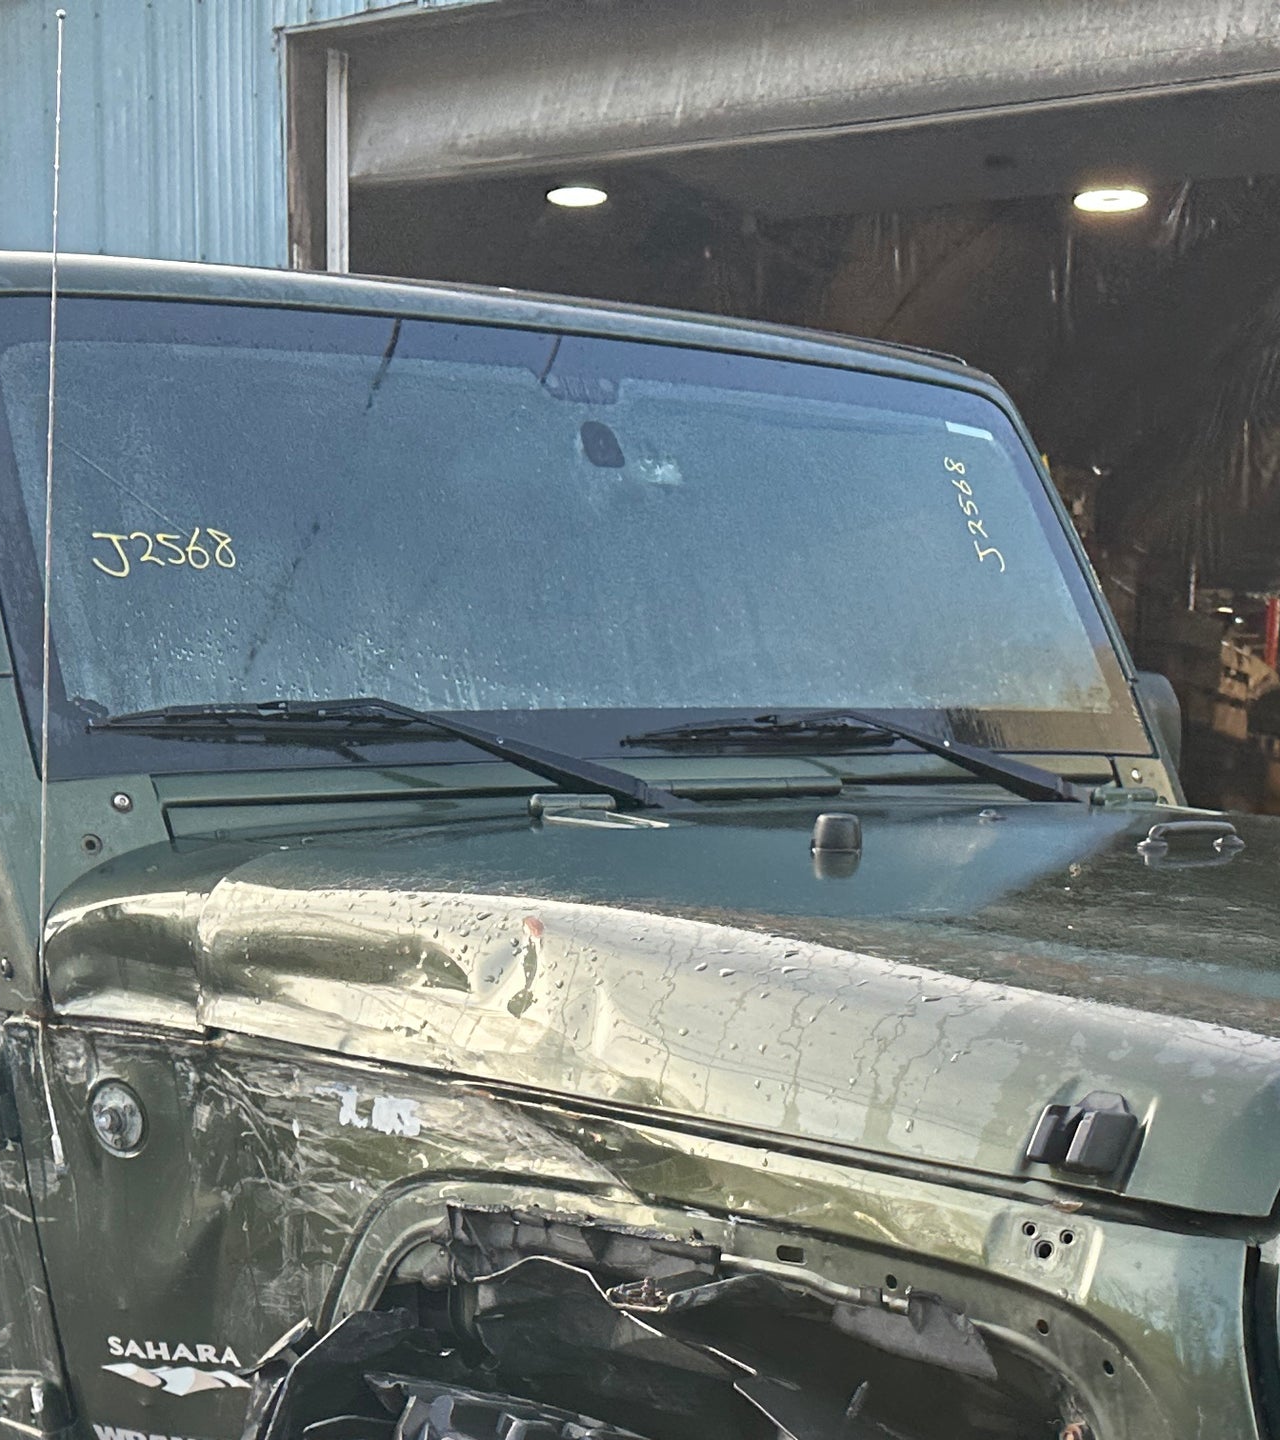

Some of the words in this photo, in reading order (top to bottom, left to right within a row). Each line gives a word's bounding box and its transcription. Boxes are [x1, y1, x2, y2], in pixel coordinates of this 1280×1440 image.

[944, 456, 1005, 573] J2568
[92, 527, 236, 577] J2568
[106, 1335, 241, 1368] SAHARA
